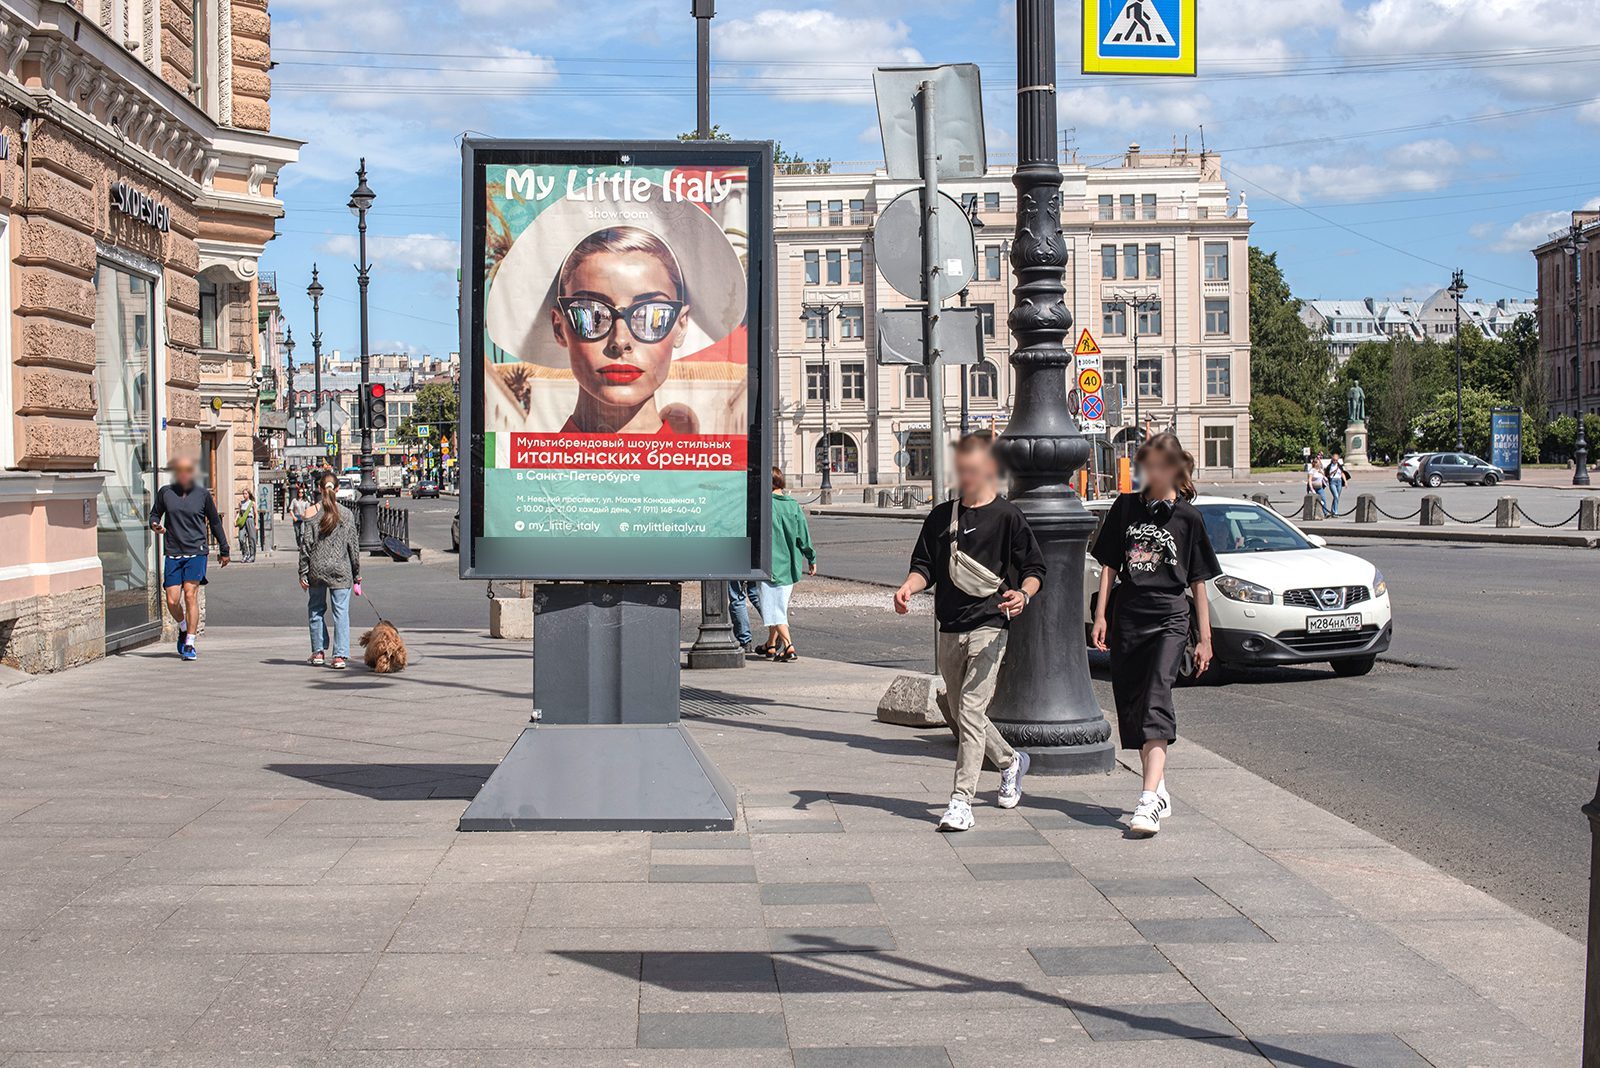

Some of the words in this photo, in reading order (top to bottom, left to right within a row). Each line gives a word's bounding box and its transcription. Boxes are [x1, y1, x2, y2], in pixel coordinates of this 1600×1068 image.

[505, 168, 555, 201] My
[566, 168, 651, 203] Little
[663, 168, 732, 204] Italy
[118, 182, 171, 233] SKDESIGN
[588, 207, 649, 220] showroom
[1084, 376, 1097, 386] 40
[516, 437, 625, 450] Мультибрендовый
[627, 440, 674, 451] шоурум
[676, 440, 731, 450] стильных
[1494, 434, 1518, 442] РУКИ
[517, 451, 642, 466] итальянских
[646, 449, 733, 469] брендов
[516, 472, 523, 481] в
[526, 471, 641, 483] Санкт-Петербурге
[516, 495, 526, 503] М.
[602, 497, 614, 505] ул.
[643, 497, 697, 505] Конюшенная,
[699, 497, 707, 505] 12
[523, 505, 544, 513] 10.00
[578, 505, 609, 514] каждый
[633, 506, 642, 514] +7
[643, 506, 659, 514] (911)
[660, 506, 702, 514] 148-40-40
[528, 520, 601, 533] my_little_italy
[633, 521, 706, 533] mylittleitaly.ru
[1346, 615, 1360, 625] 178
